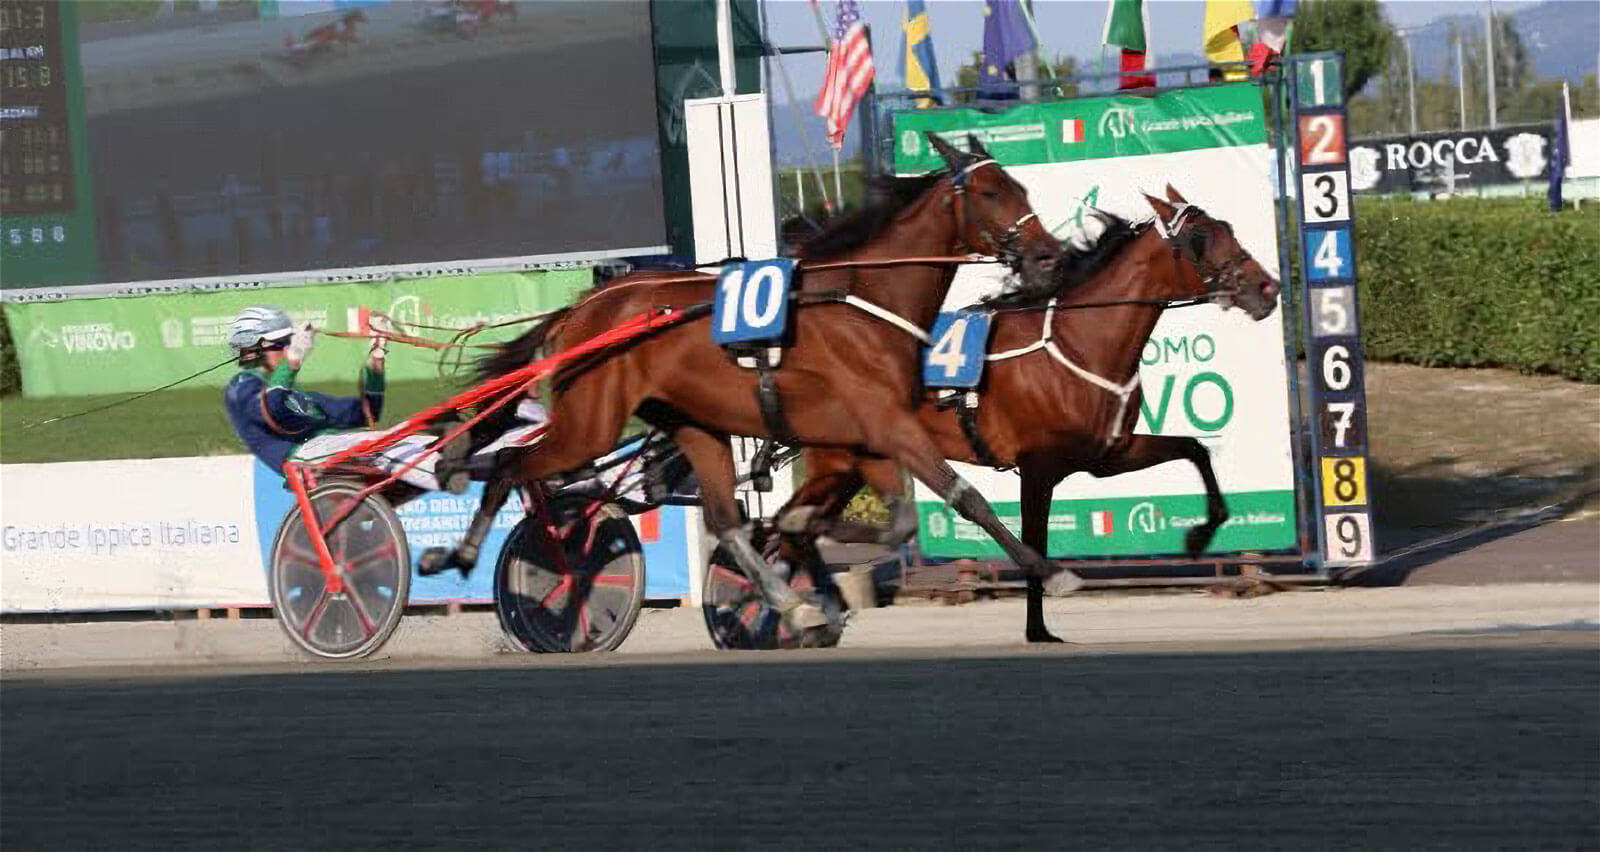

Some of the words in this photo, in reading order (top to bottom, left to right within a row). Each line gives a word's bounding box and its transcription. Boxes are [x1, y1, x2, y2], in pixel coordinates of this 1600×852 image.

[1310, 59, 1325, 106] 1
[1308, 116, 1339, 163] 2
[1386, 135, 1500, 170] ROCCA
[1314, 175, 1338, 218] 3
[1313, 229, 1344, 277] 4
[720, 264, 784, 332] 10
[1319, 289, 1347, 333] 5
[928, 318, 969, 377] 4
[1323, 345, 1351, 390] 6
[1327, 402, 1355, 448] 7
[1333, 459, 1358, 502] 8
[3, 523, 81, 550] Grande
[87, 522, 152, 555] Ippica
[159, 521, 240, 546] Italiana
[1335, 515, 1362, 558] 9
